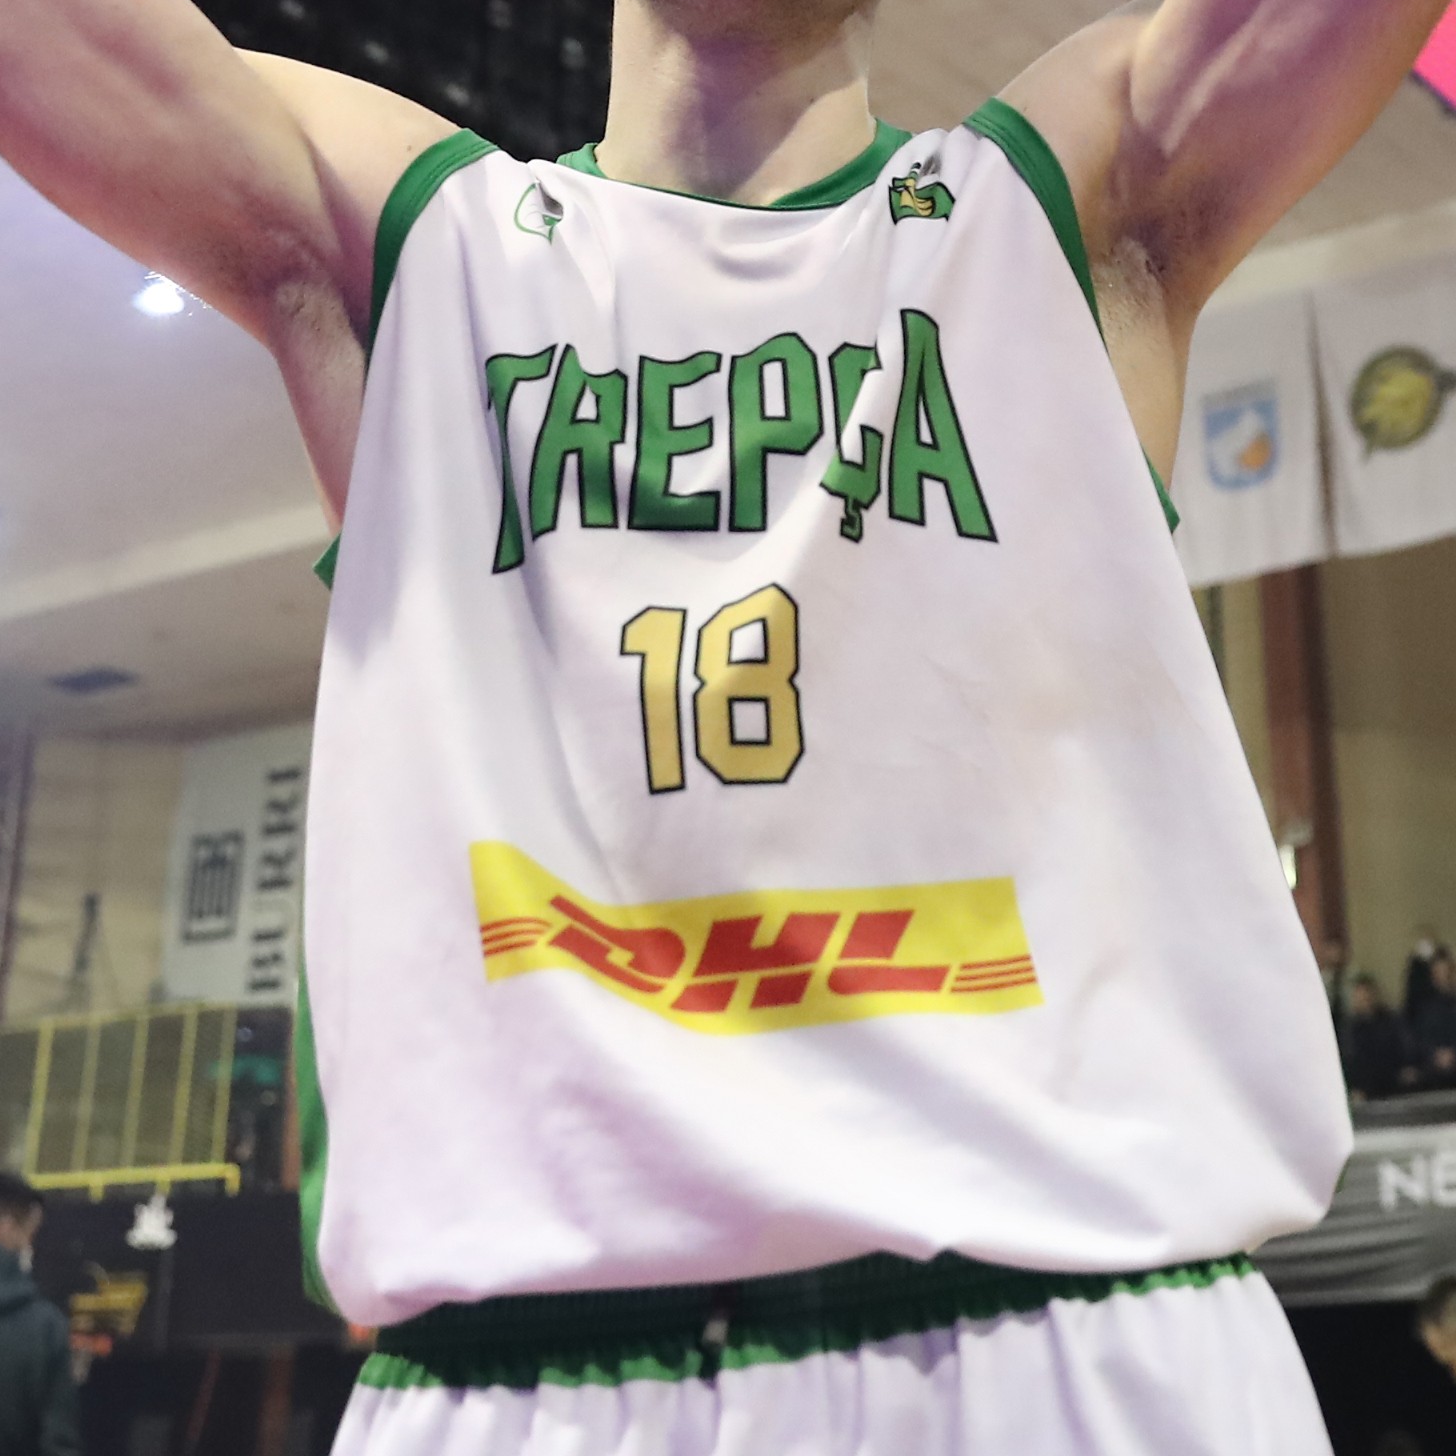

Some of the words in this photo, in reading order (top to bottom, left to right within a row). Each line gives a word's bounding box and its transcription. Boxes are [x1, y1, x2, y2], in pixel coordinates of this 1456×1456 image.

[485, 308, 999, 574] TREPÇA
[620, 582, 805, 794] 18
[545, 895, 950, 1014] DHL
